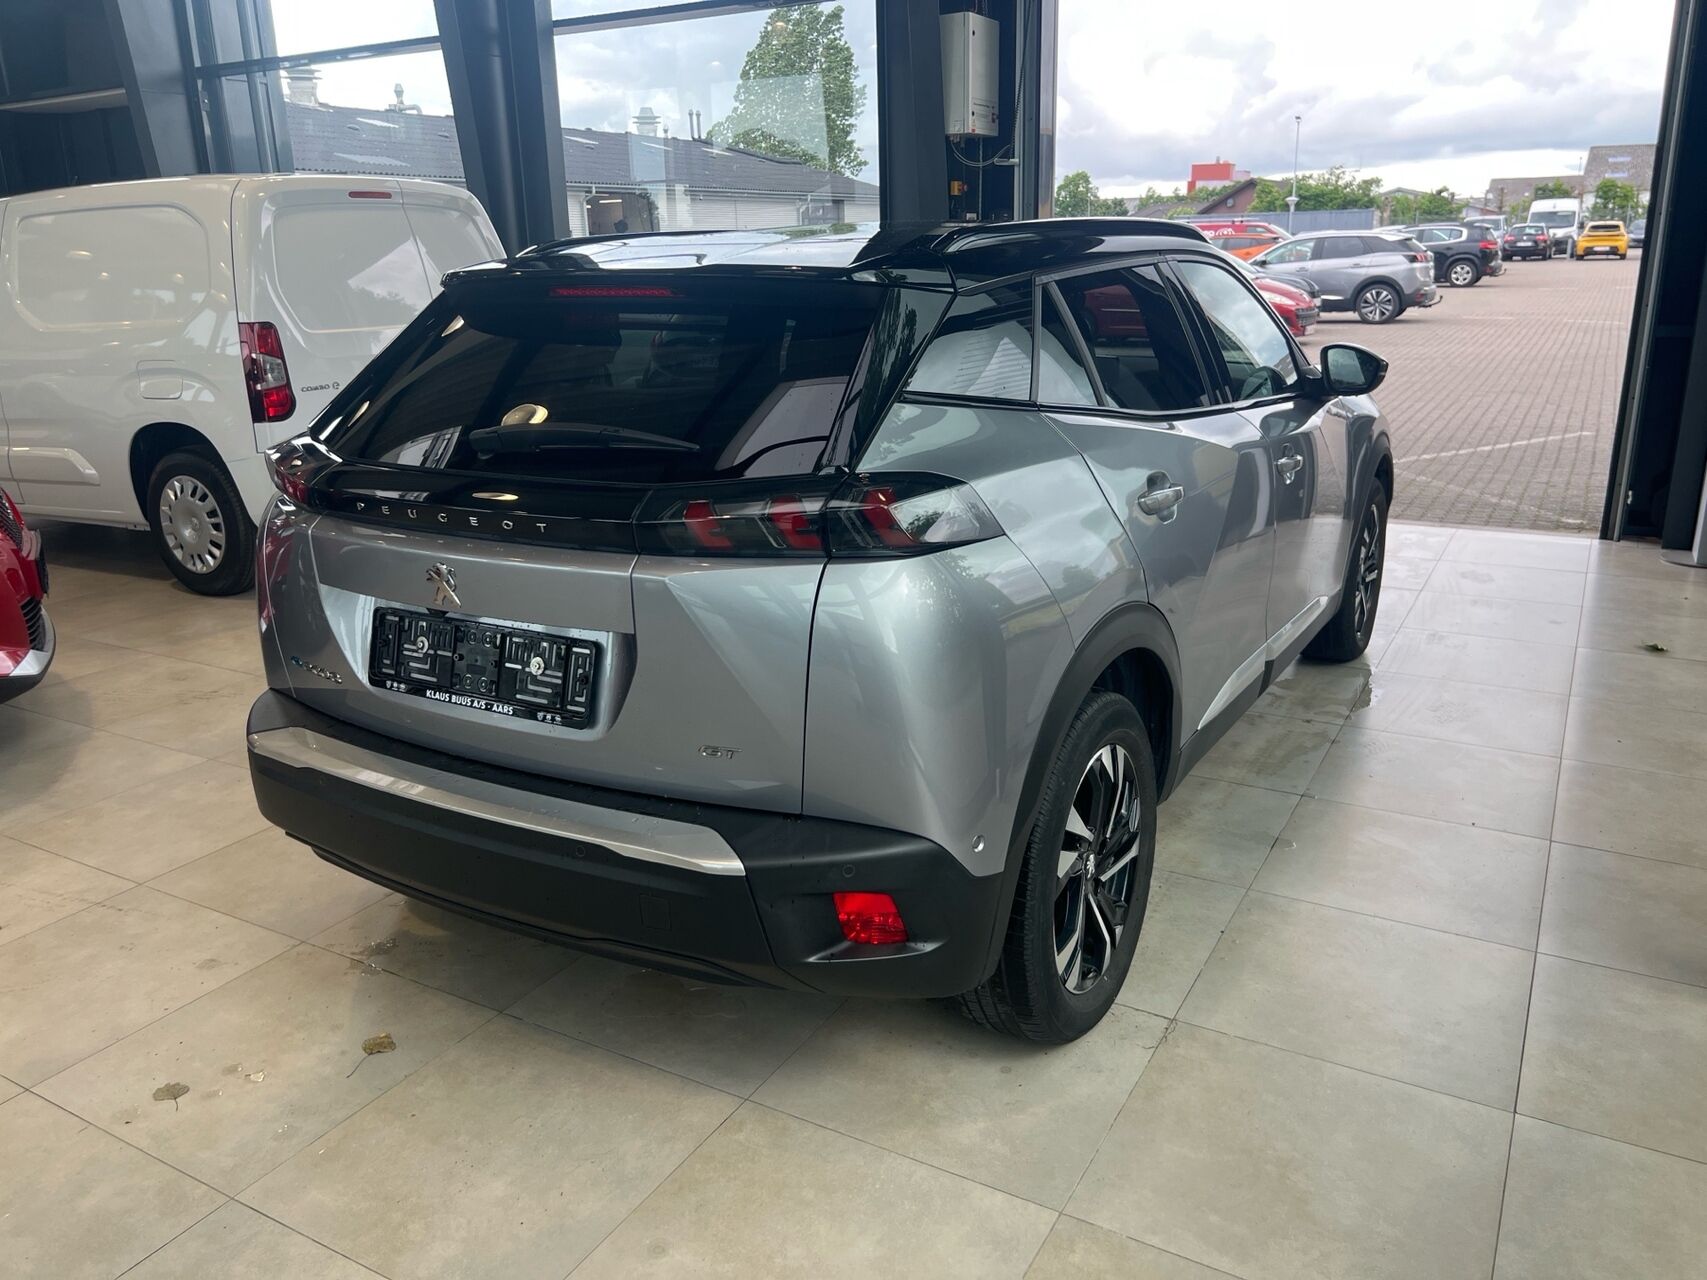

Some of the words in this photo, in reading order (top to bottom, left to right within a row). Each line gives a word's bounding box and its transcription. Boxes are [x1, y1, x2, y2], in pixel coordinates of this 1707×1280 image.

[356, 501, 547, 533] PEUGEOT
[426, 689, 450, 701] KLAUS
[451, 695, 471, 706] BUUS
[472, 699, 486, 709] A/S
[492, 703, 514, 715] AARS
[697, 744, 743, 760] GT
